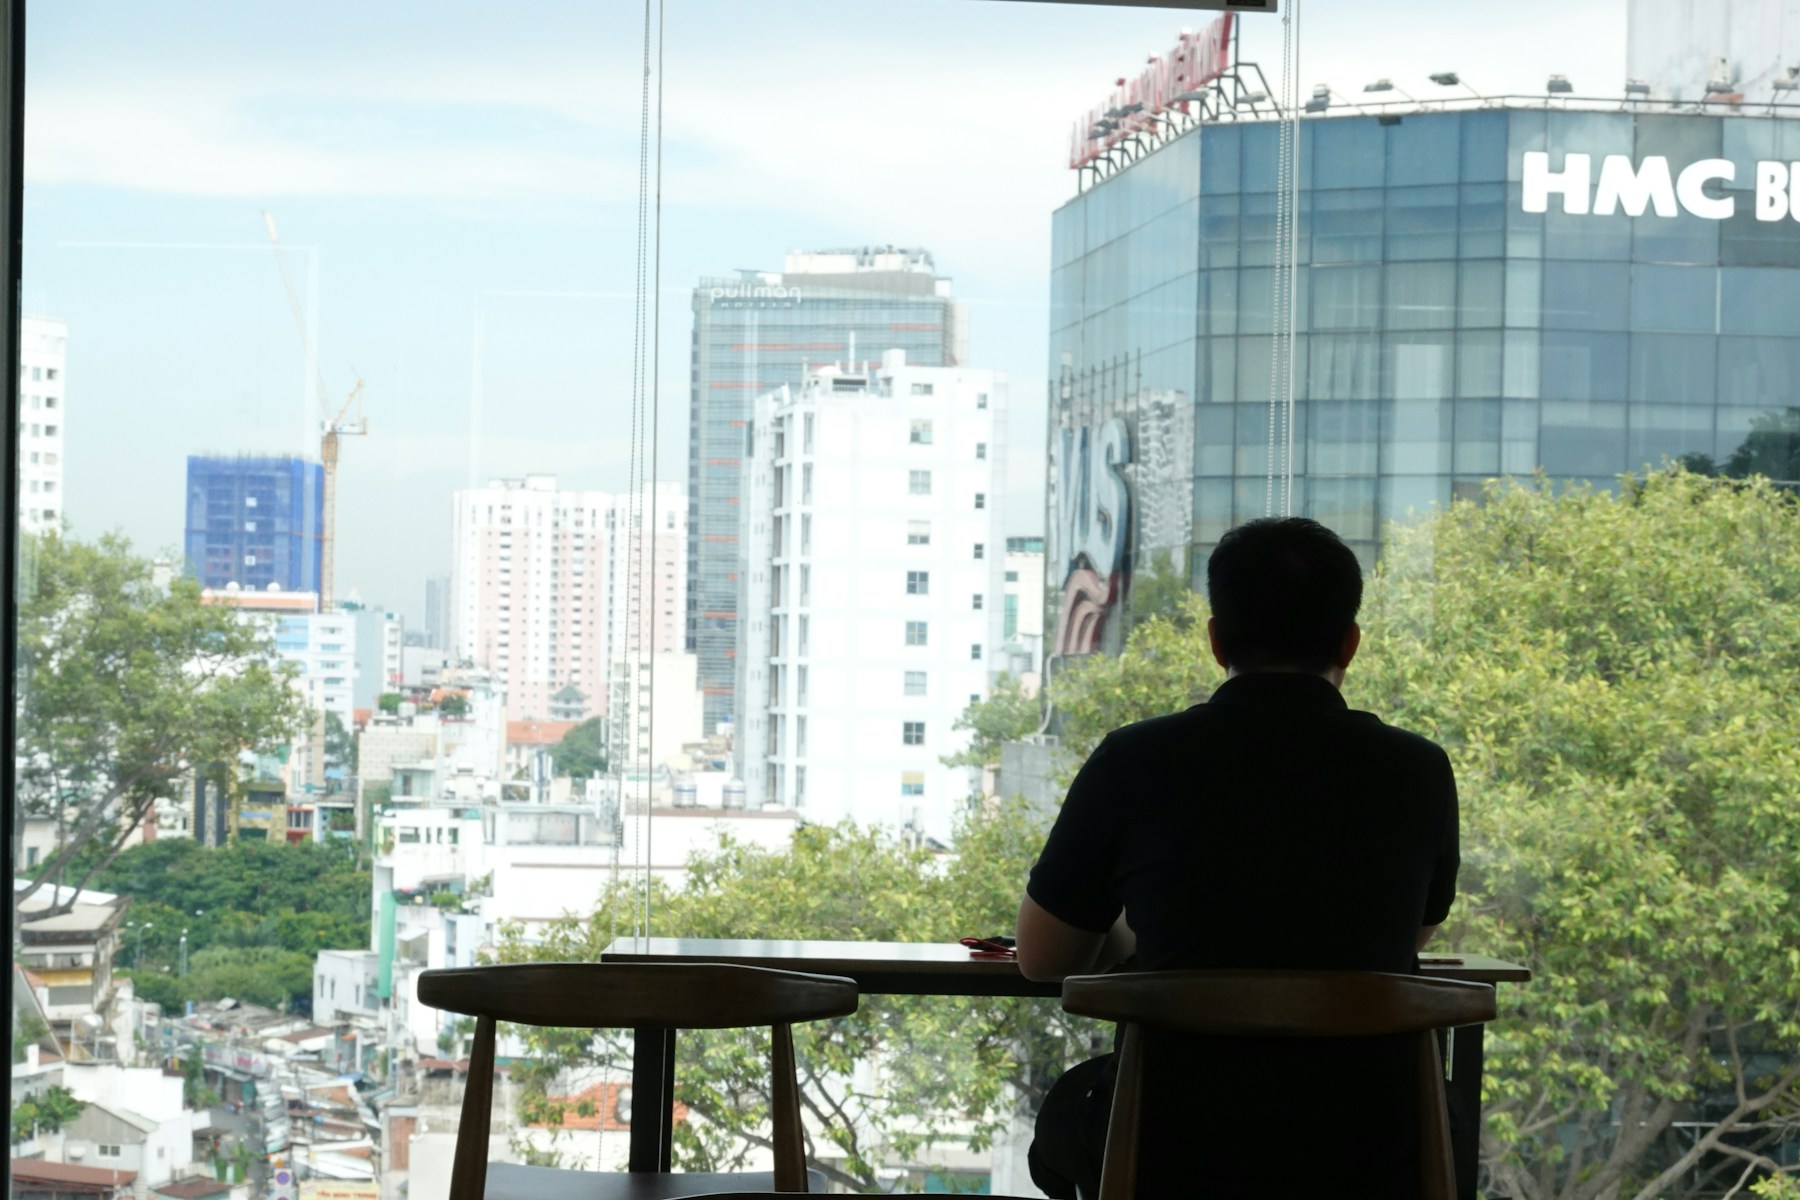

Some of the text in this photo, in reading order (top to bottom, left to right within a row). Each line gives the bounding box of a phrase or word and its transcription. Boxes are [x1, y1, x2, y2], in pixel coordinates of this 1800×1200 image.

[1522, 152, 1736, 219] HMC
[711, 283, 801, 303] pullman
[1057, 417, 1130, 592] VUS
